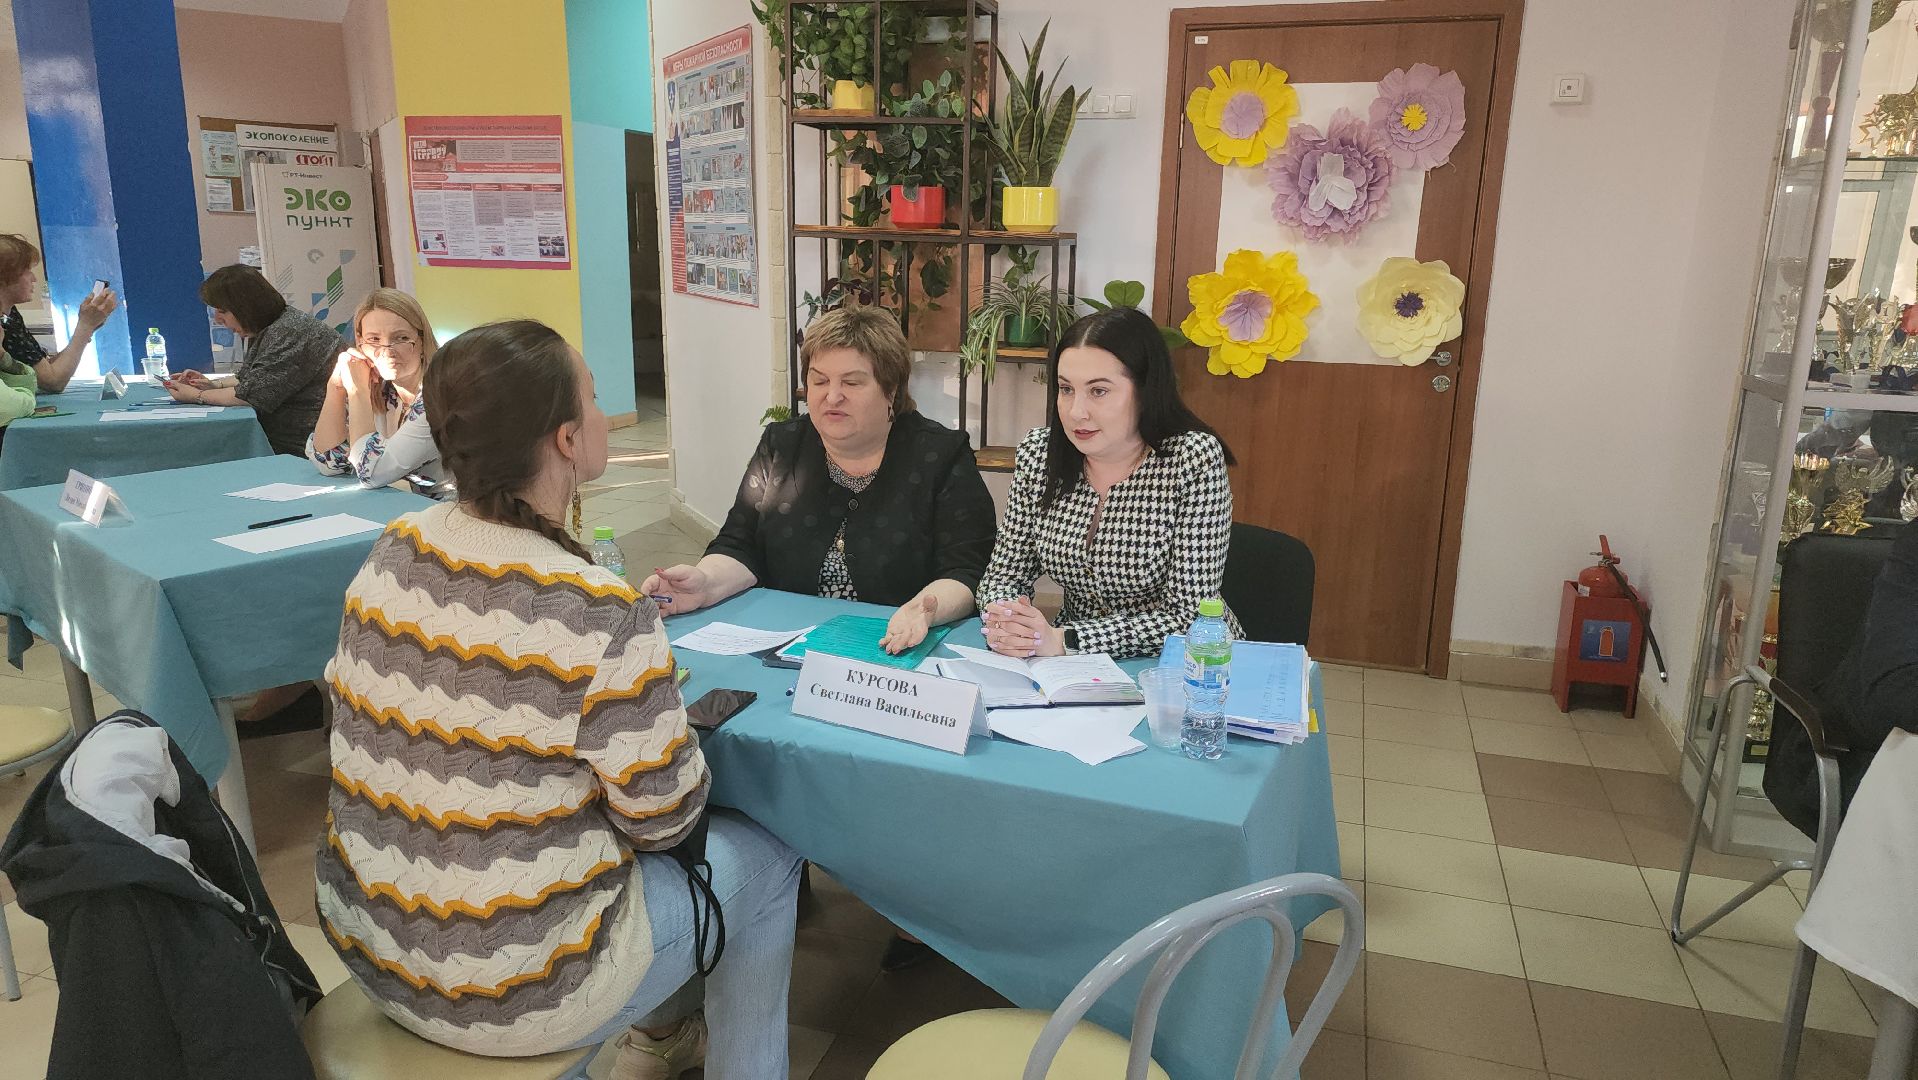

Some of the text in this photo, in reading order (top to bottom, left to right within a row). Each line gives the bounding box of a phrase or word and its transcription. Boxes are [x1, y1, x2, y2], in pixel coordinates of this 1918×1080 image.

[245, 131, 329, 144] ЭКОПОКОЛЕНИЕ
[284, 187, 352, 212] ЭКО
[846, 669, 919, 697] КУРСОВА
[810, 682, 957, 728] Светлана Васильевна
